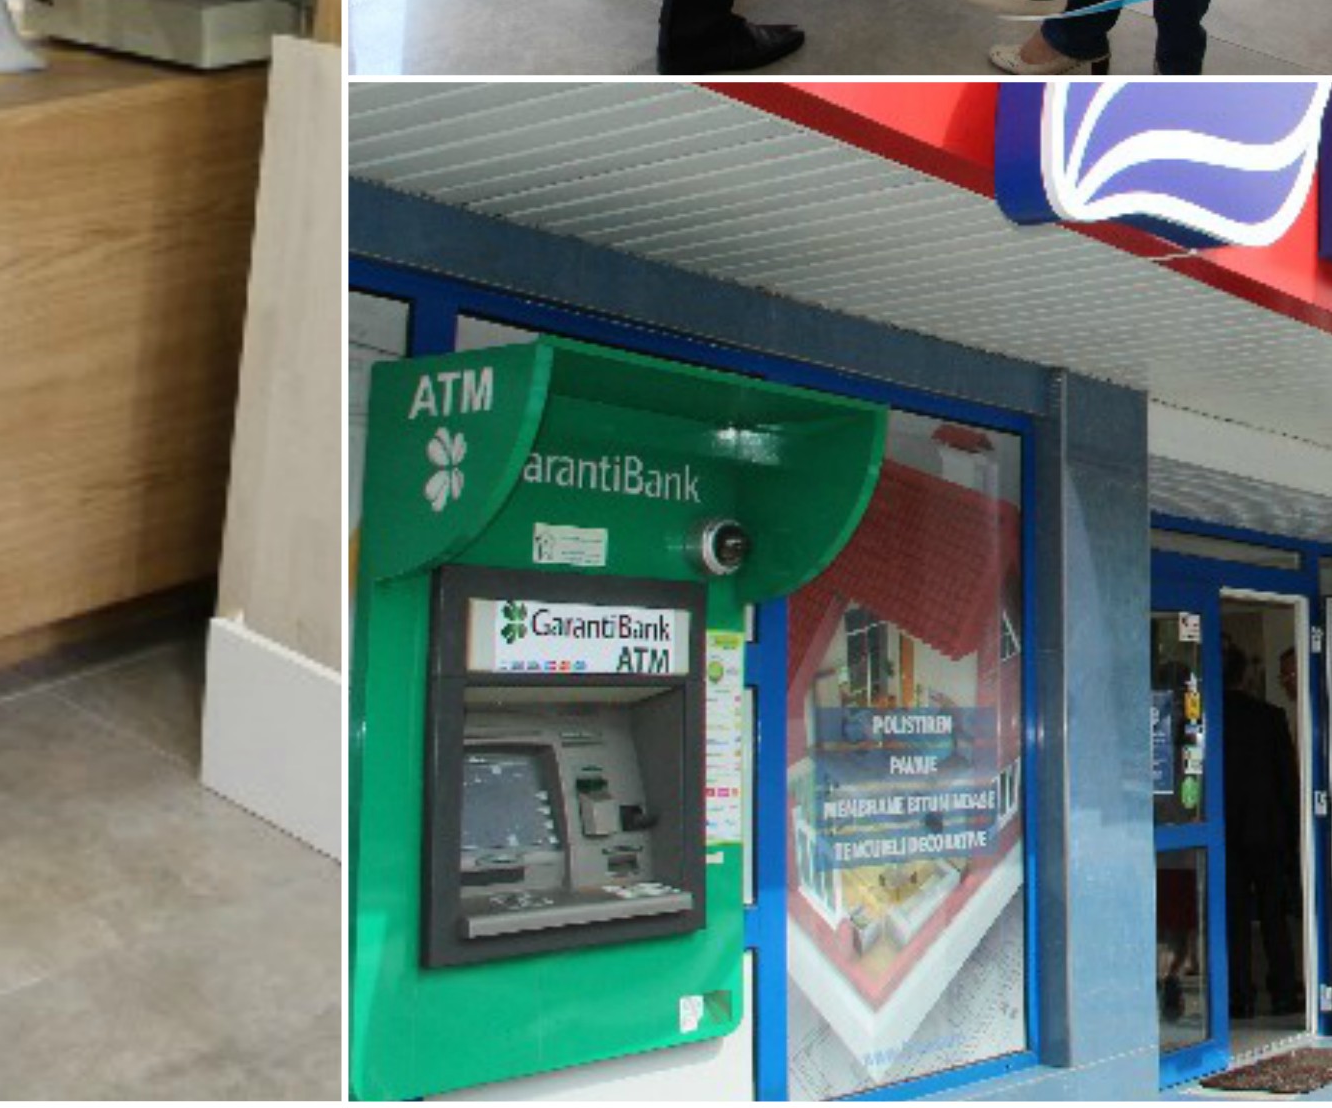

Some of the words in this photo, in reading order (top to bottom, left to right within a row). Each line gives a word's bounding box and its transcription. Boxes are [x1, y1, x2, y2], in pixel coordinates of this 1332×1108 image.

[408, 367, 495, 419] ATM
[522, 451, 701, 503] arantiBank
[531, 608, 671, 642] GarantiBank
[615, 646, 671, 674] ATM
[872, 715, 952, 735] POLISTIREN
